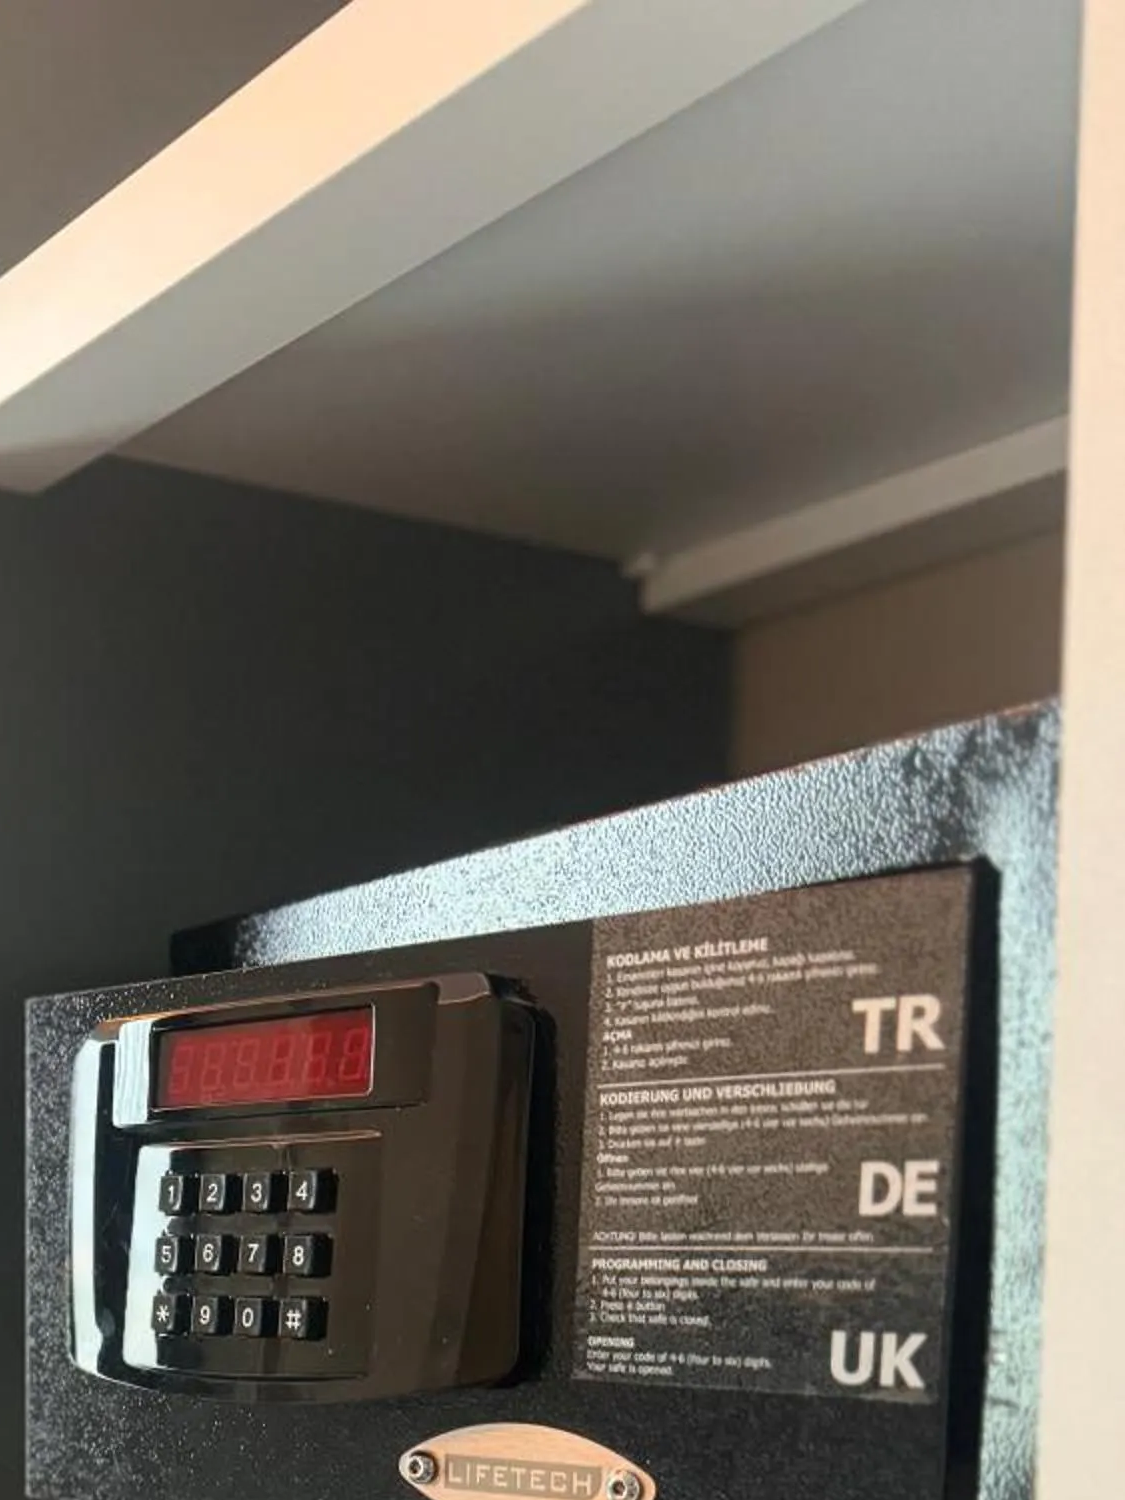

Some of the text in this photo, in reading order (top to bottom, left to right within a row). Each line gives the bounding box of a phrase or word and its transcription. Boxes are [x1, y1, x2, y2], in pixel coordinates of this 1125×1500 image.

[606, 950, 670, 969] KODLAMA
[674, 945, 691, 961] VE
[852, 993, 946, 1054] TR
[600, 1087, 680, 1107] KODIERUNG
[682, 1086, 712, 1101] UND
[167, 1180, 308, 1203] 1 2 3 4
[858, 1159, 940, 1217] DE
[161, 1243, 305, 1266] 5 6 7 8
[592, 1258, 768, 1273] PROGRAMMING AND CLOSING
[200, 1304, 302, 1330] 9 0 #
[830, 1329, 928, 1390] UK
[447, 1461, 593, 1496] LIFETECH
